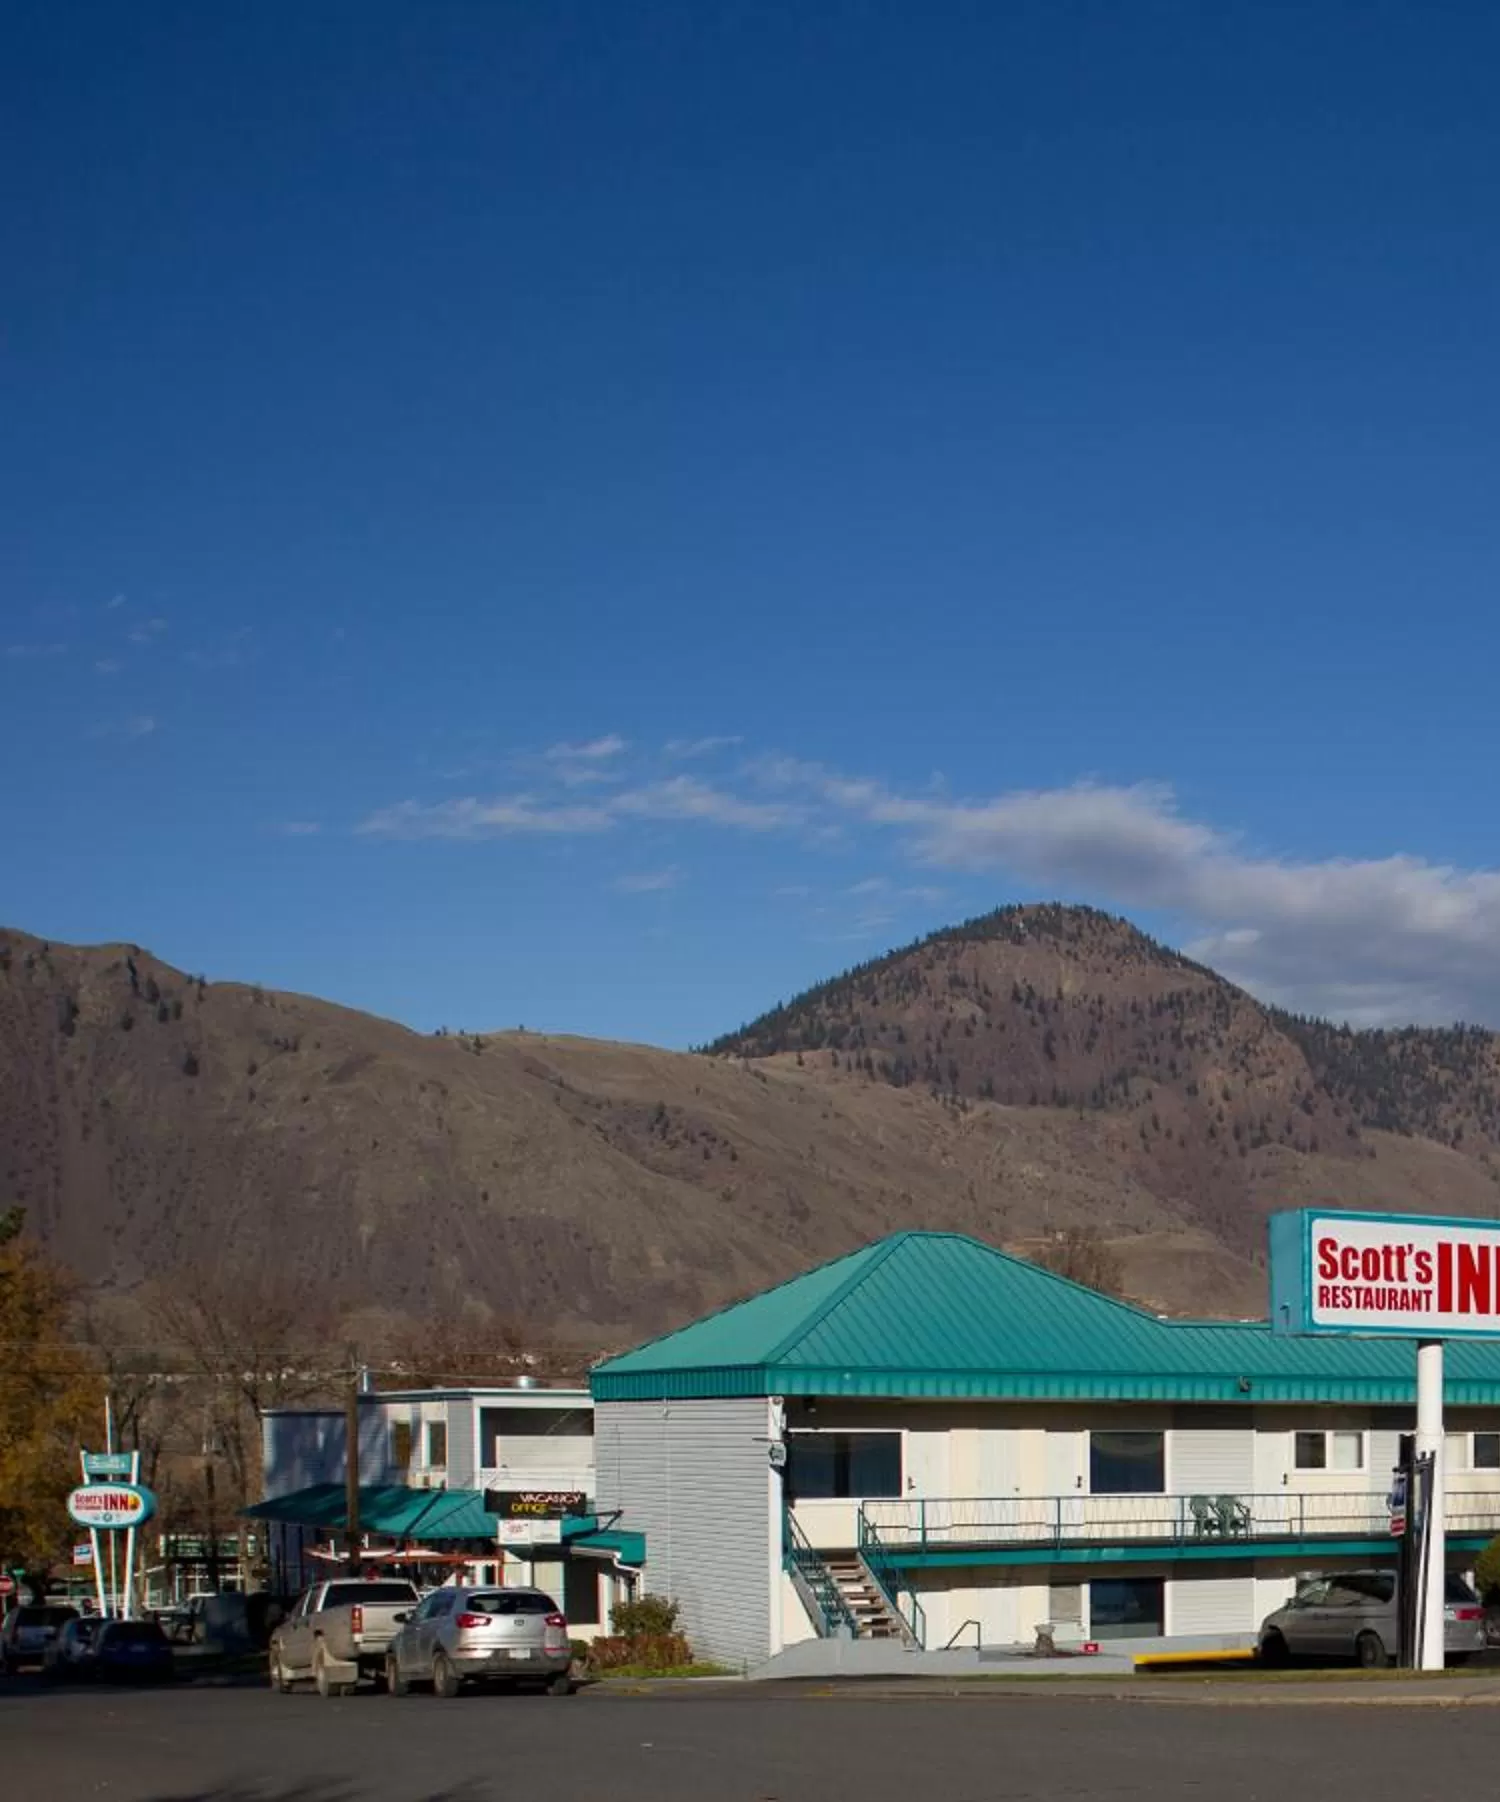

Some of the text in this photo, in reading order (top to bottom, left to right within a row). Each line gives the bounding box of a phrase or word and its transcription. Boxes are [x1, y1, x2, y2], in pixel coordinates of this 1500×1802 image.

[1317, 1237, 1433, 1284] Scott's
[1318, 1285, 1433, 1312] RESTAURANT
[104, 1494, 129, 1511] INN
[519, 1493, 580, 1504] VACANCY
[511, 1503, 548, 1513] OFFICE
